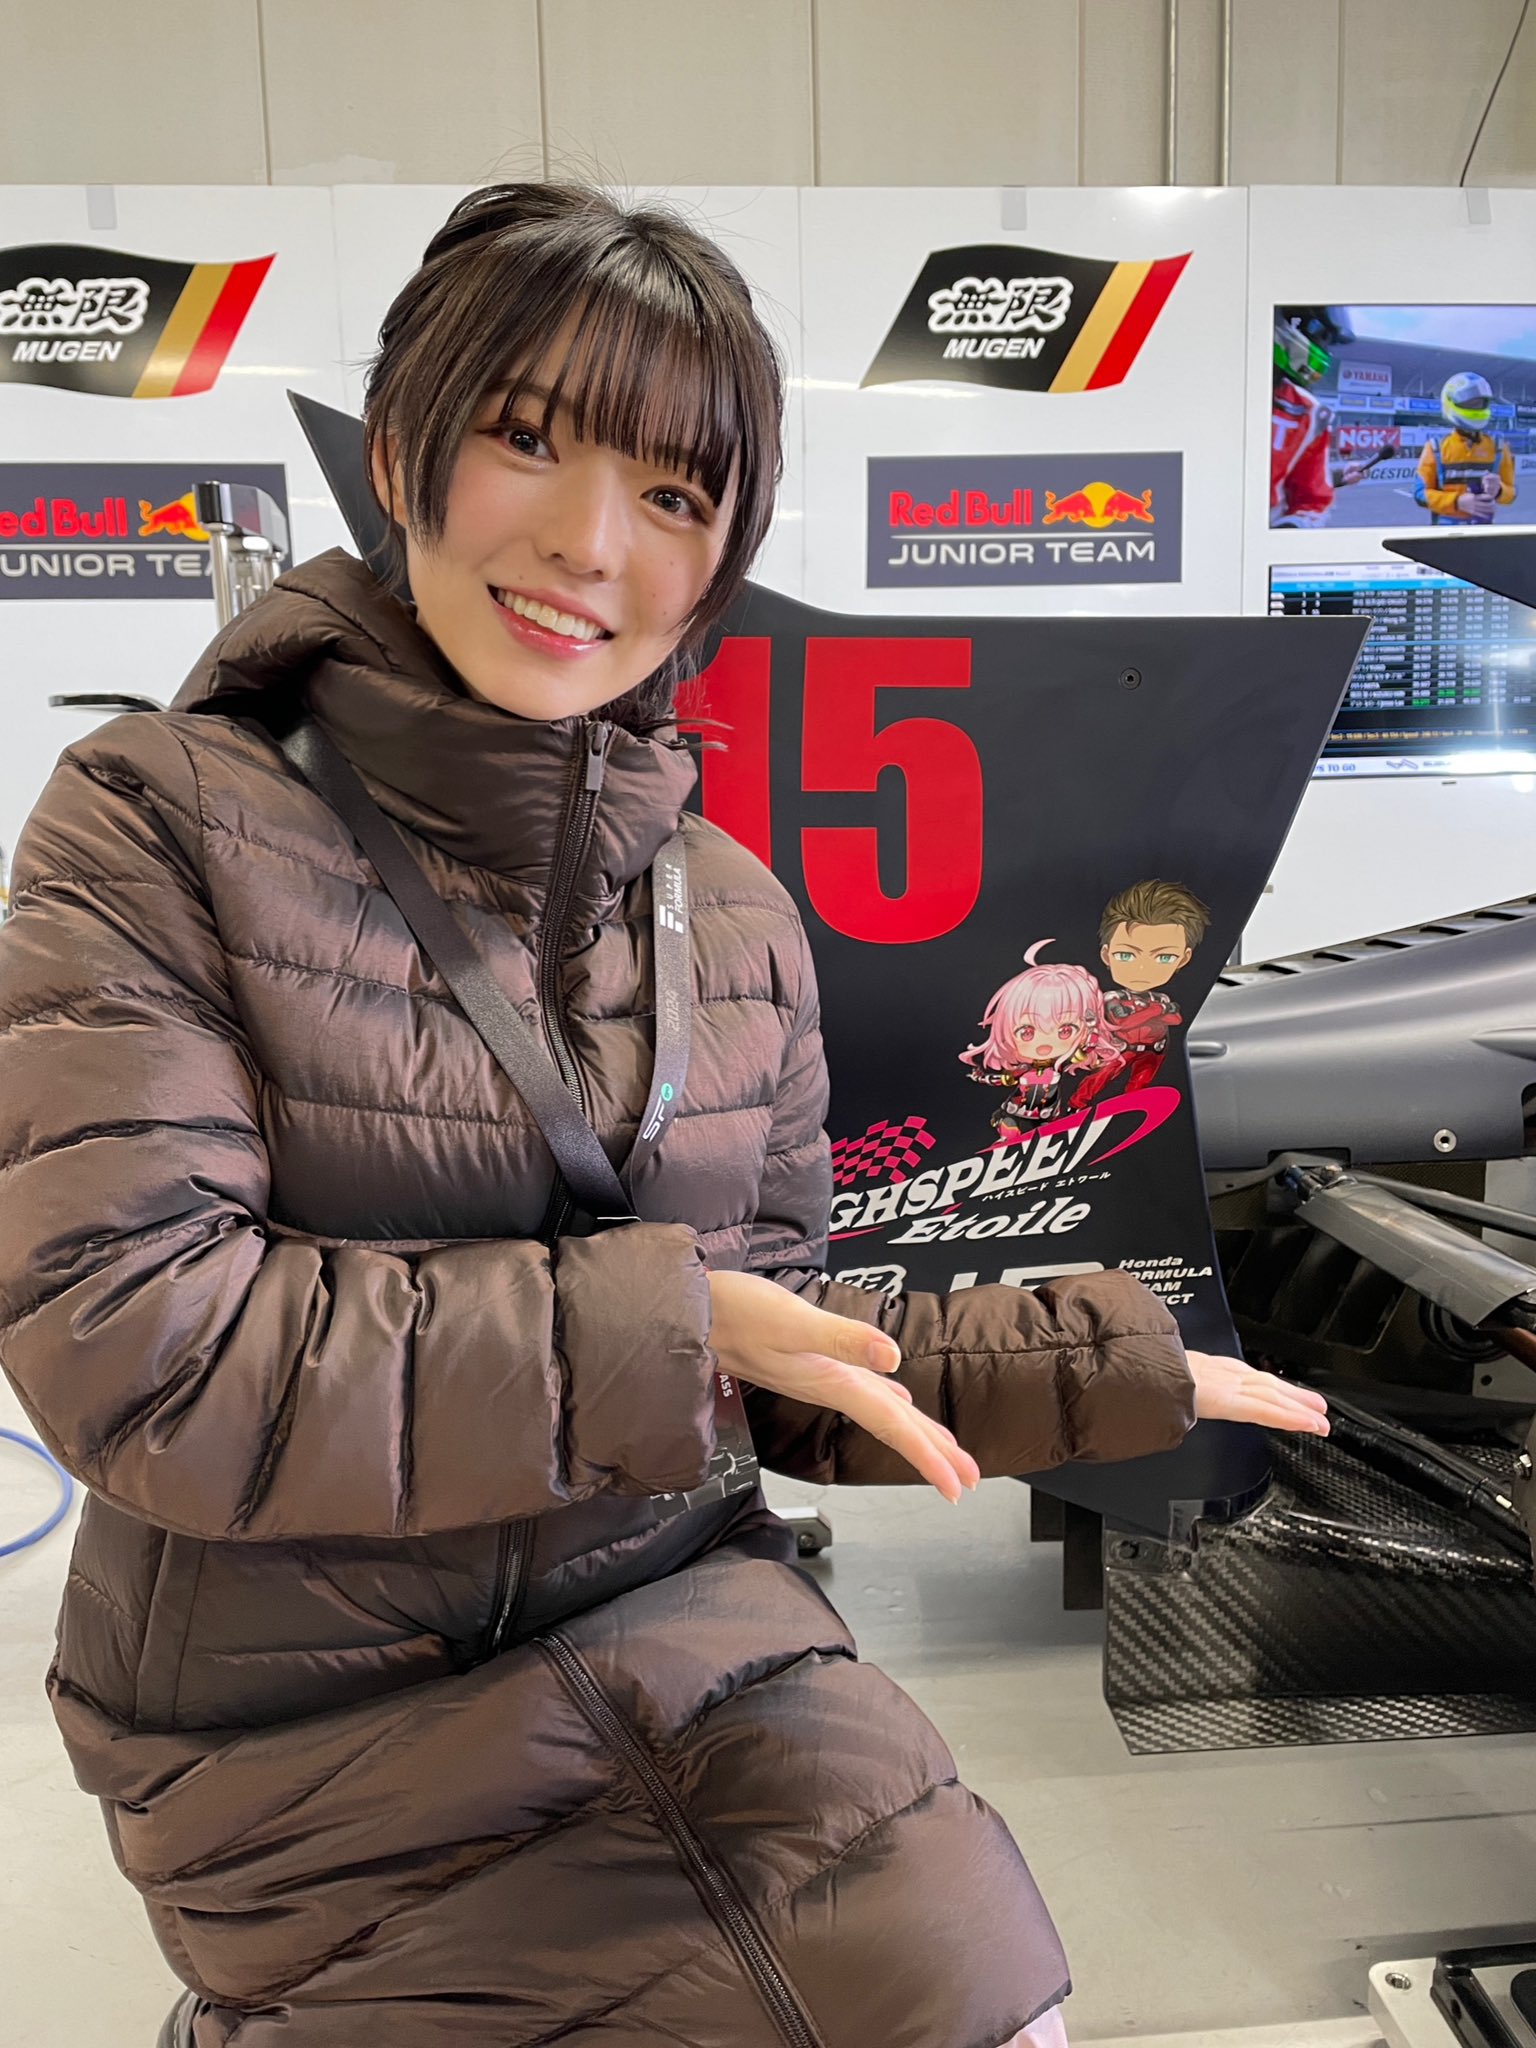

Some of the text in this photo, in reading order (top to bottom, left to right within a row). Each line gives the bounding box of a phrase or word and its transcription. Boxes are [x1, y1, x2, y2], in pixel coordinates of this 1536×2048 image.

[928, 276, 1074, 334] 無限
[12, 340, 123, 363] MUGEN
[942, 337, 1045, 360] MUGEN
[1340, 429, 1387, 448] NGK
[51, 497, 128, 537] Bull
[888, 488, 1032, 528] Red Bull
[0, 553, 136, 578] UNIOR
[888, 540, 1155, 565] JUNIOR TEAM
[672, 636, 983, 944] 15
[665, 862, 674, 910] SUPER
[673, 866, 684, 915] FORMULA
[828, 1086, 1182, 1233] GHSPEED
[1118, 1255, 1184, 1270] Honda
[1129, 1266, 1214, 1281] ORMULA
[719, 1373, 734, 1399] ASS
